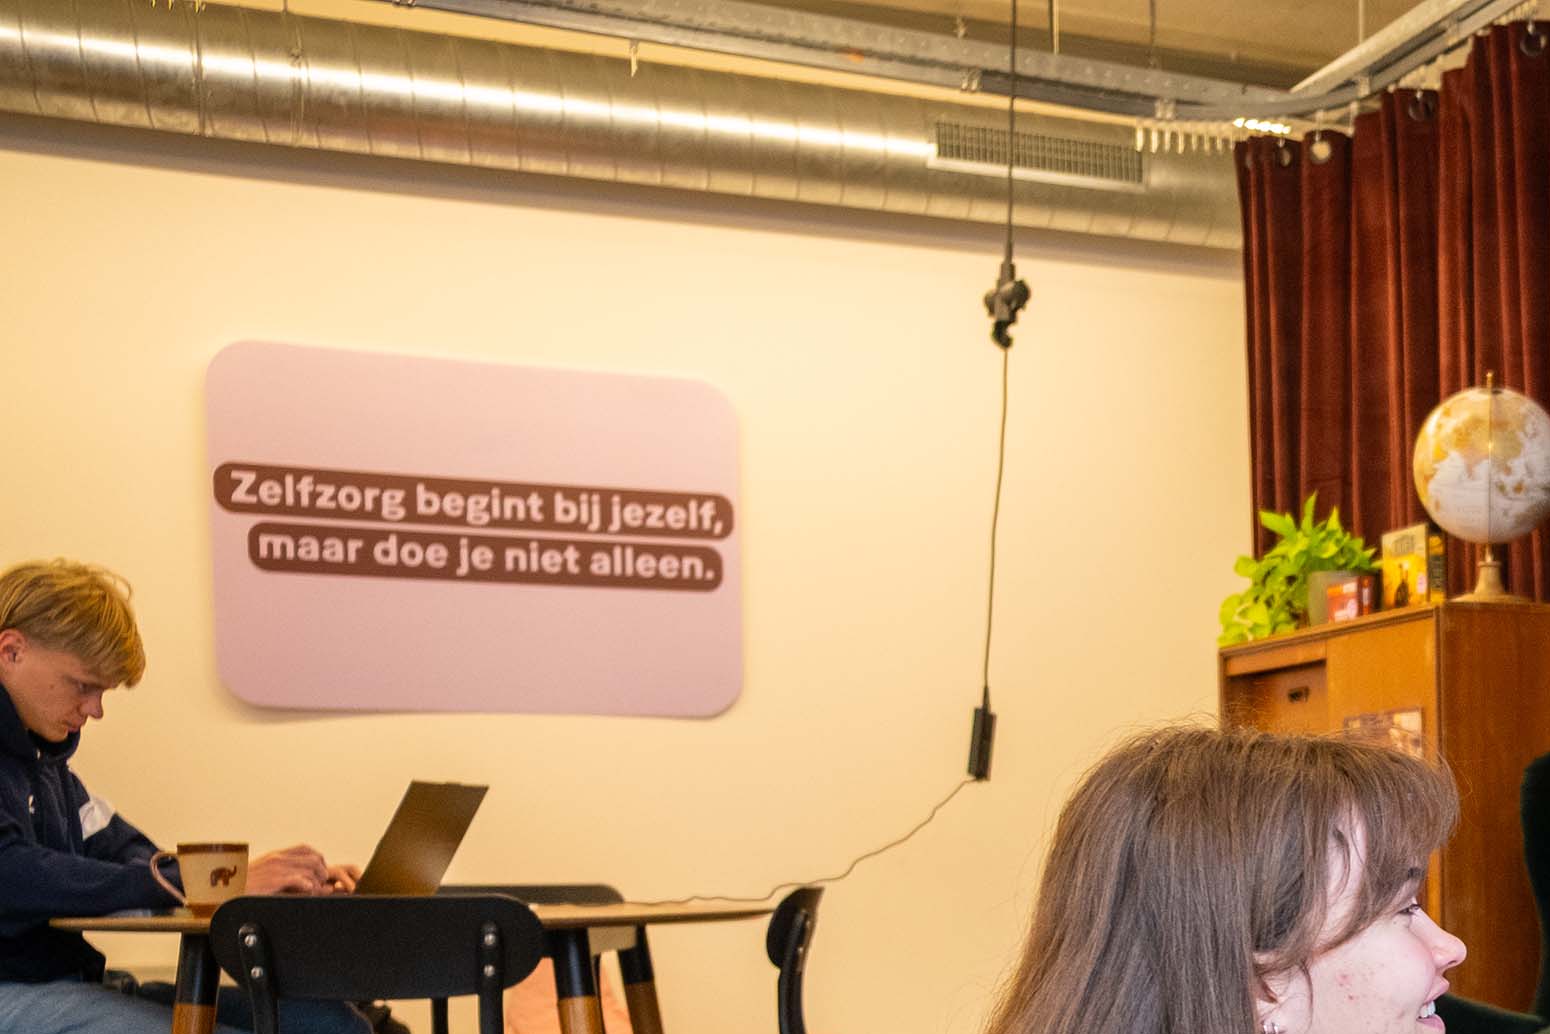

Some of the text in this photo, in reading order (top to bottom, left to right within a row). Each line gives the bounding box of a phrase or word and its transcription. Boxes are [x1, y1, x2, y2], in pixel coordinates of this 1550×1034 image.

[230, 469, 724, 536] Zelfzorg begint bij jezelf,
[258, 533, 715, 581] maar doe je niet alleen.
